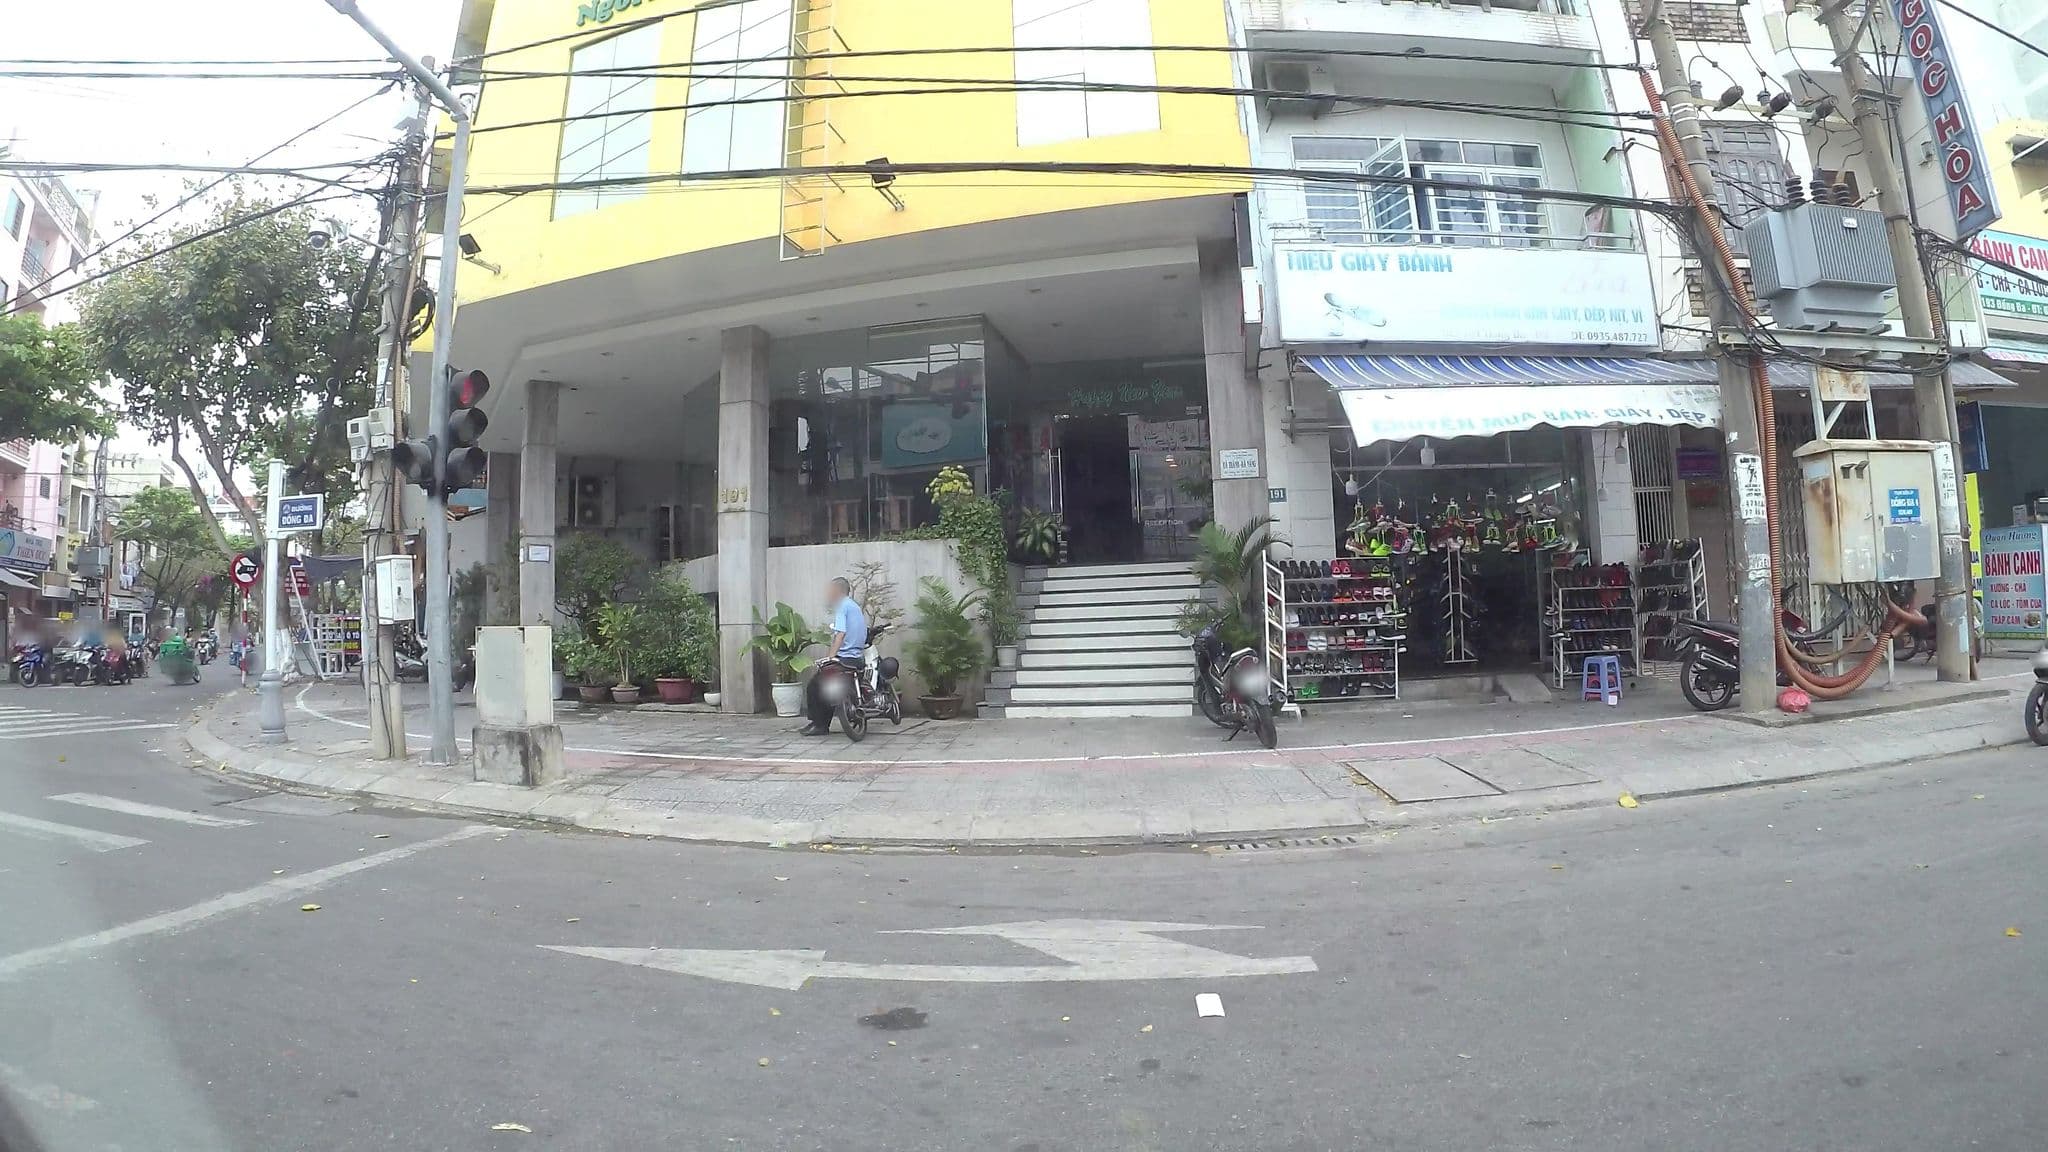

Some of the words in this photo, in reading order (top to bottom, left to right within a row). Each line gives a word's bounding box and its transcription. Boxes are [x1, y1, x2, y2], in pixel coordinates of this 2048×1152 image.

[1898, 0, 1947, 96] GỌC
[1934, 101, 1985, 220] HÒA
[2018, 245, 2048, 271] CAN
[1269, 489, 1284, 499] 191
[1984, 548, 2011, 577] BÁNH
[2013, 551, 2041, 576] CANH
